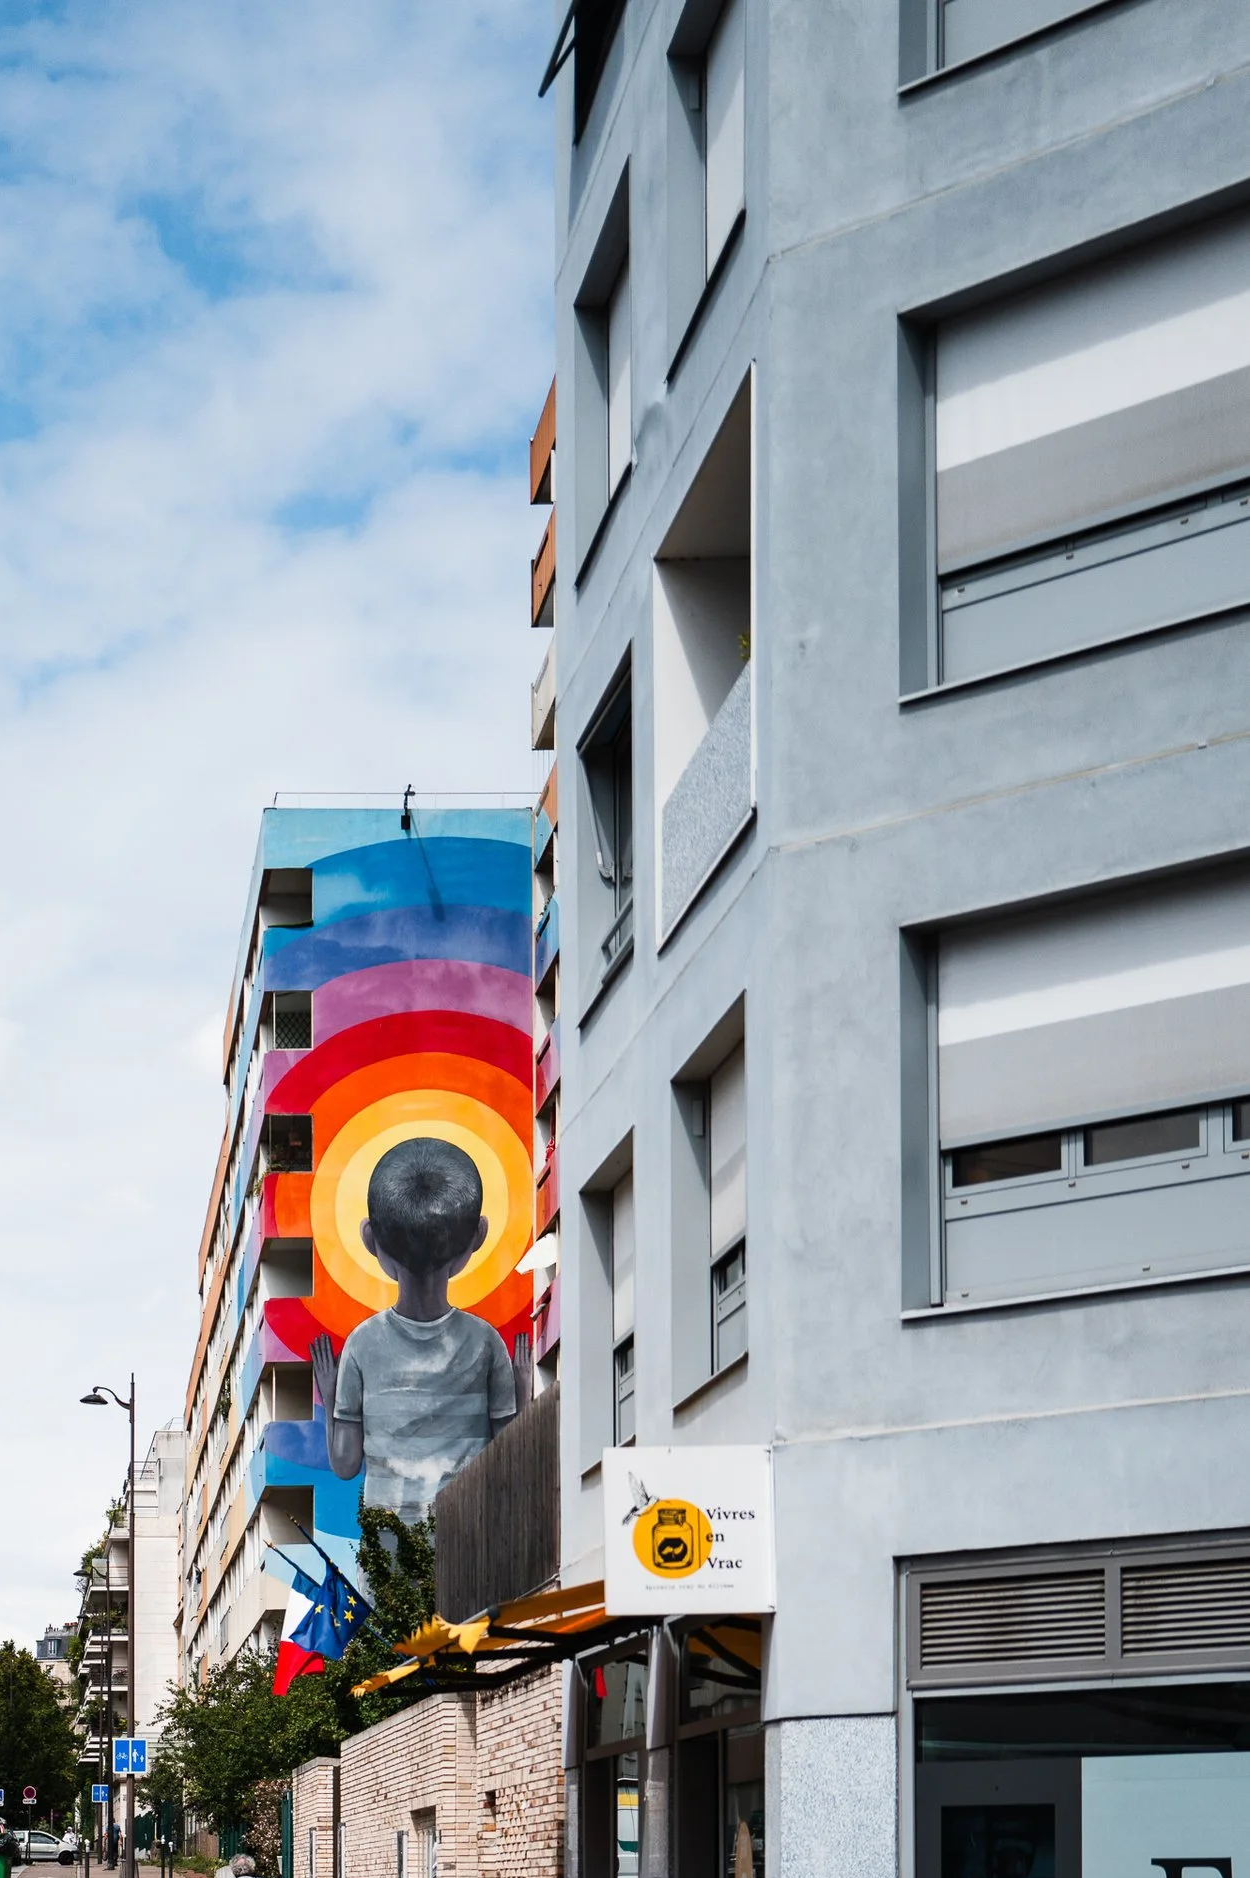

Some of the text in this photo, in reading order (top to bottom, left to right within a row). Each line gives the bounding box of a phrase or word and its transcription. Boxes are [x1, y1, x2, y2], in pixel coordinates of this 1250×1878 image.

[706, 1506, 755, 1520] Vivres
[706, 1532, 724, 1542] en
[707, 1557, 742, 1568] Vrac
